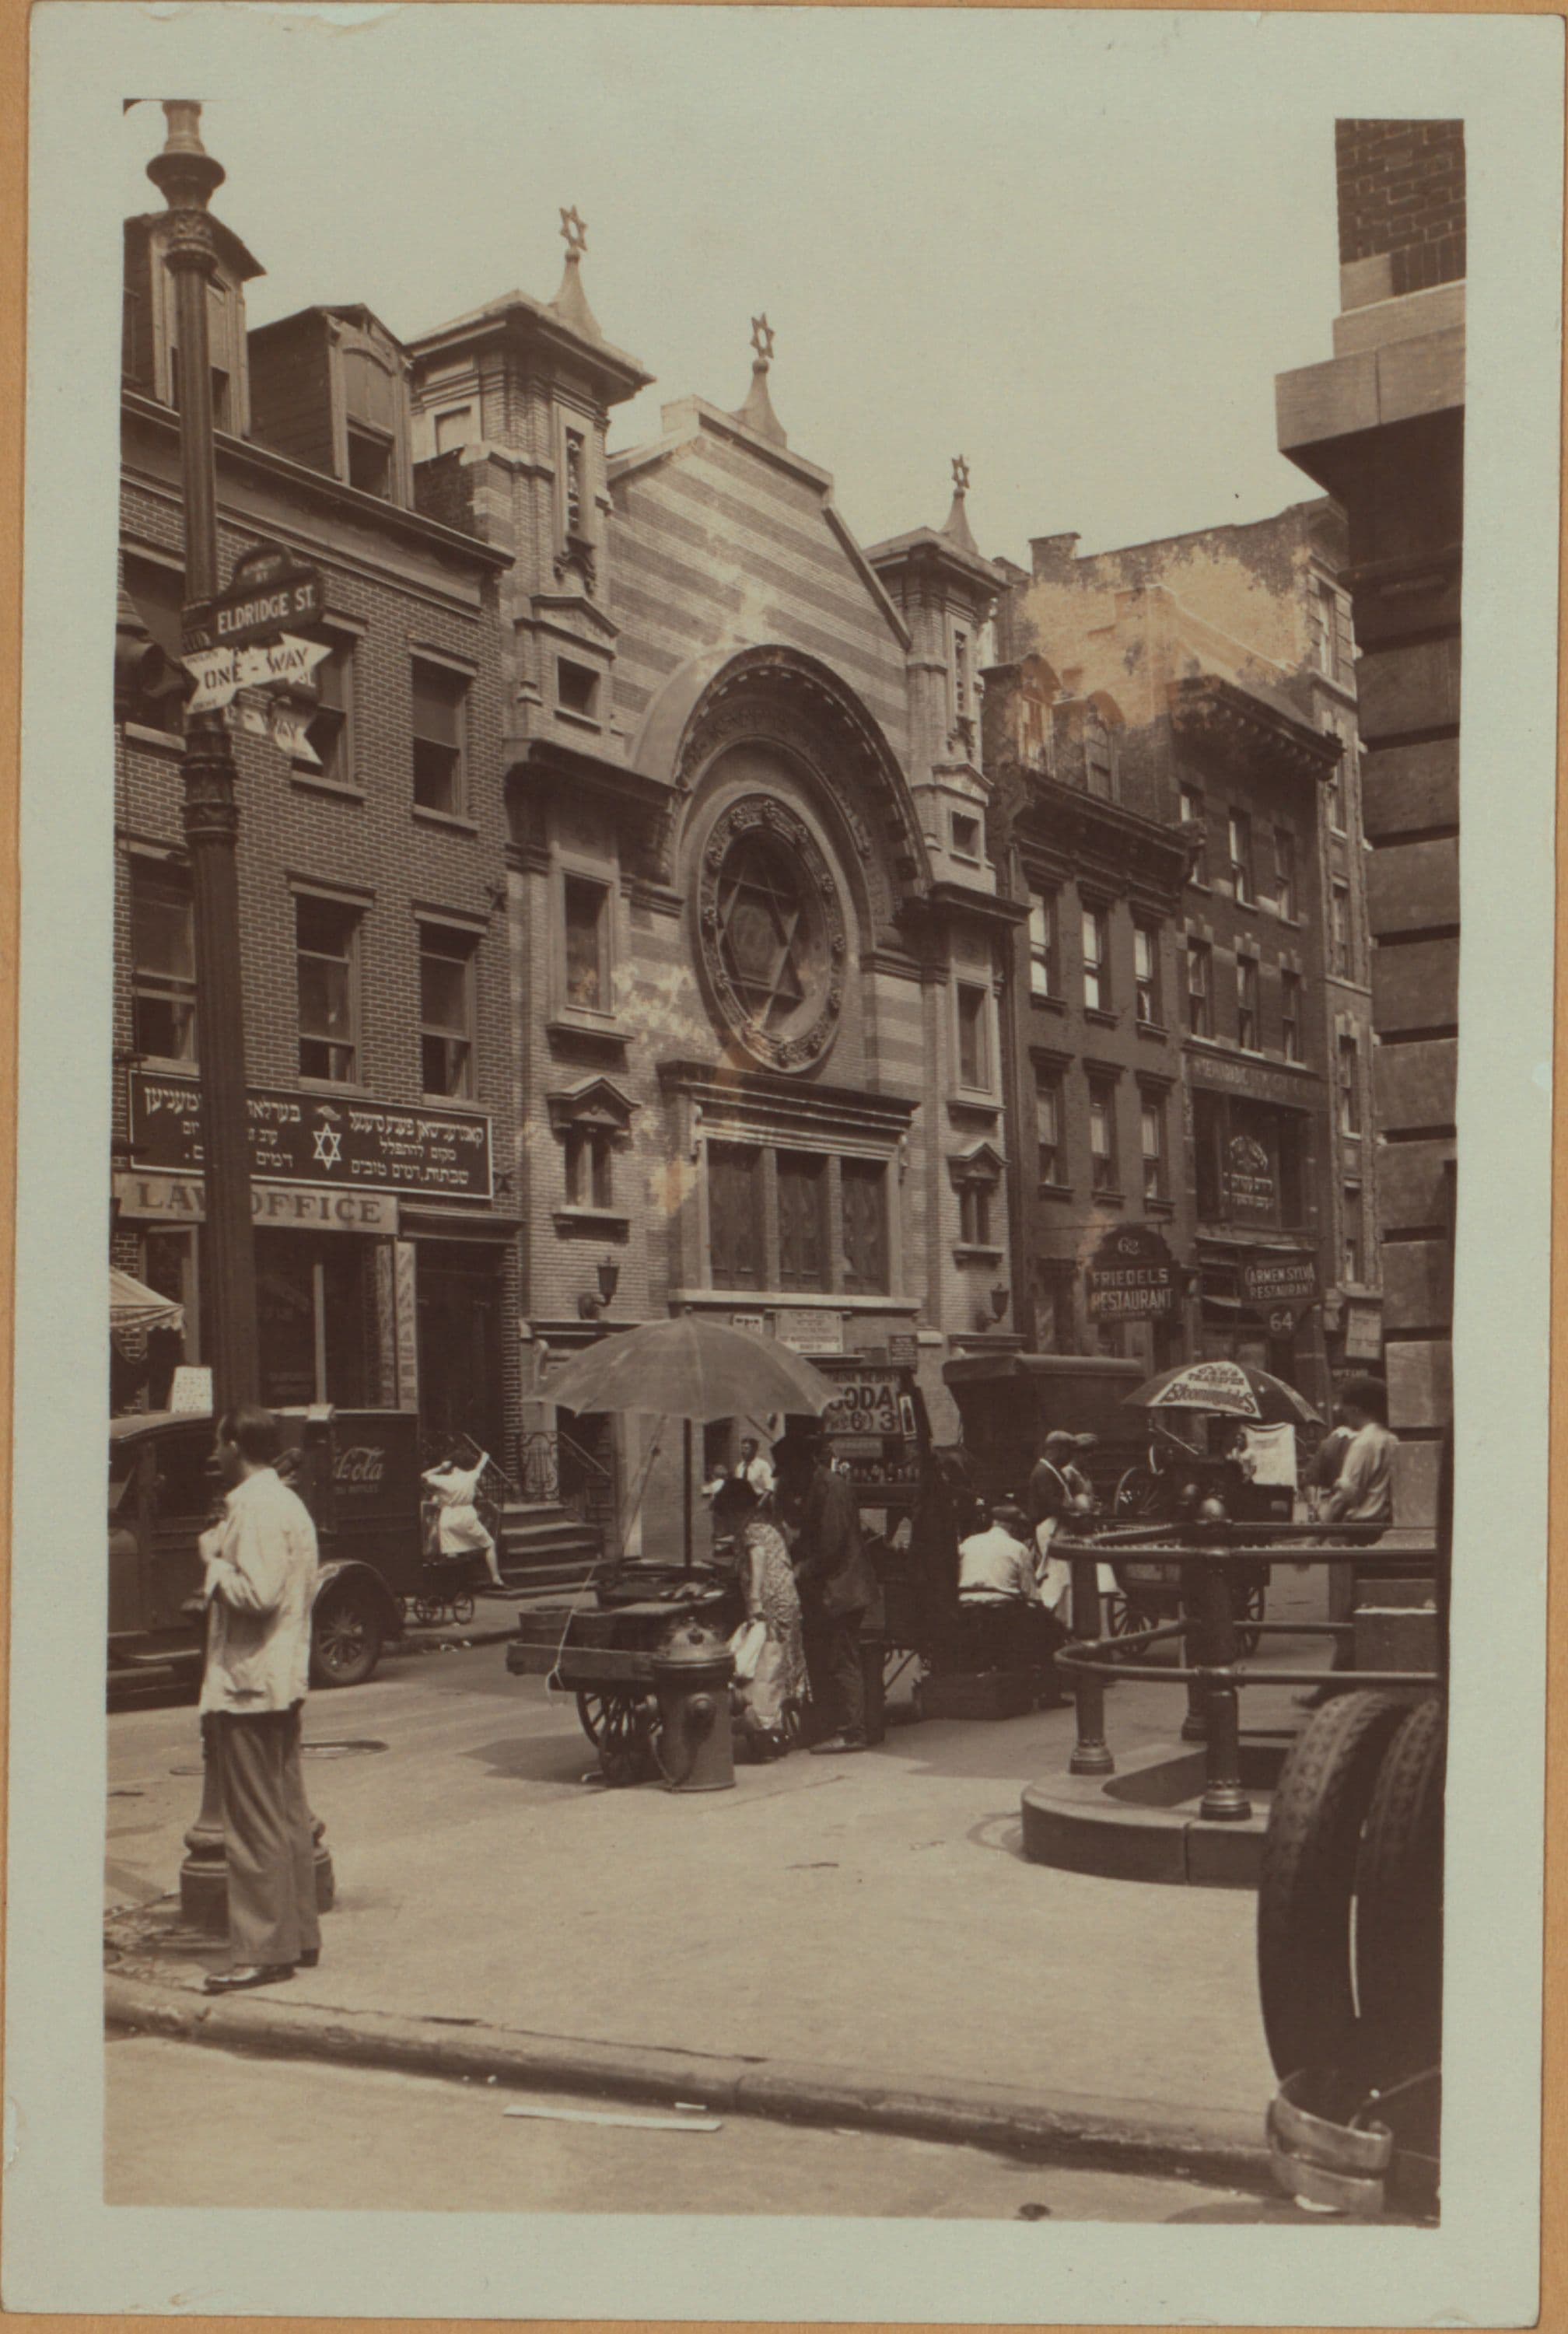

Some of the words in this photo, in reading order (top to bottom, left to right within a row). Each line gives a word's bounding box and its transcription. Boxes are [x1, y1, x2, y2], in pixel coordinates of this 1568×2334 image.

[218, 593, 289, 635] ELDRIDGE
[205, 665, 242, 690] ONE
[267, 647, 308, 673] WAY
[1244, 1265, 1285, 1285] CARMEN
[1090, 1288, 1174, 1311] RESTAURANT
[1249, 1282, 1314, 1300] RESTAURANT
[1269, 1311, 1294, 1331] 64
